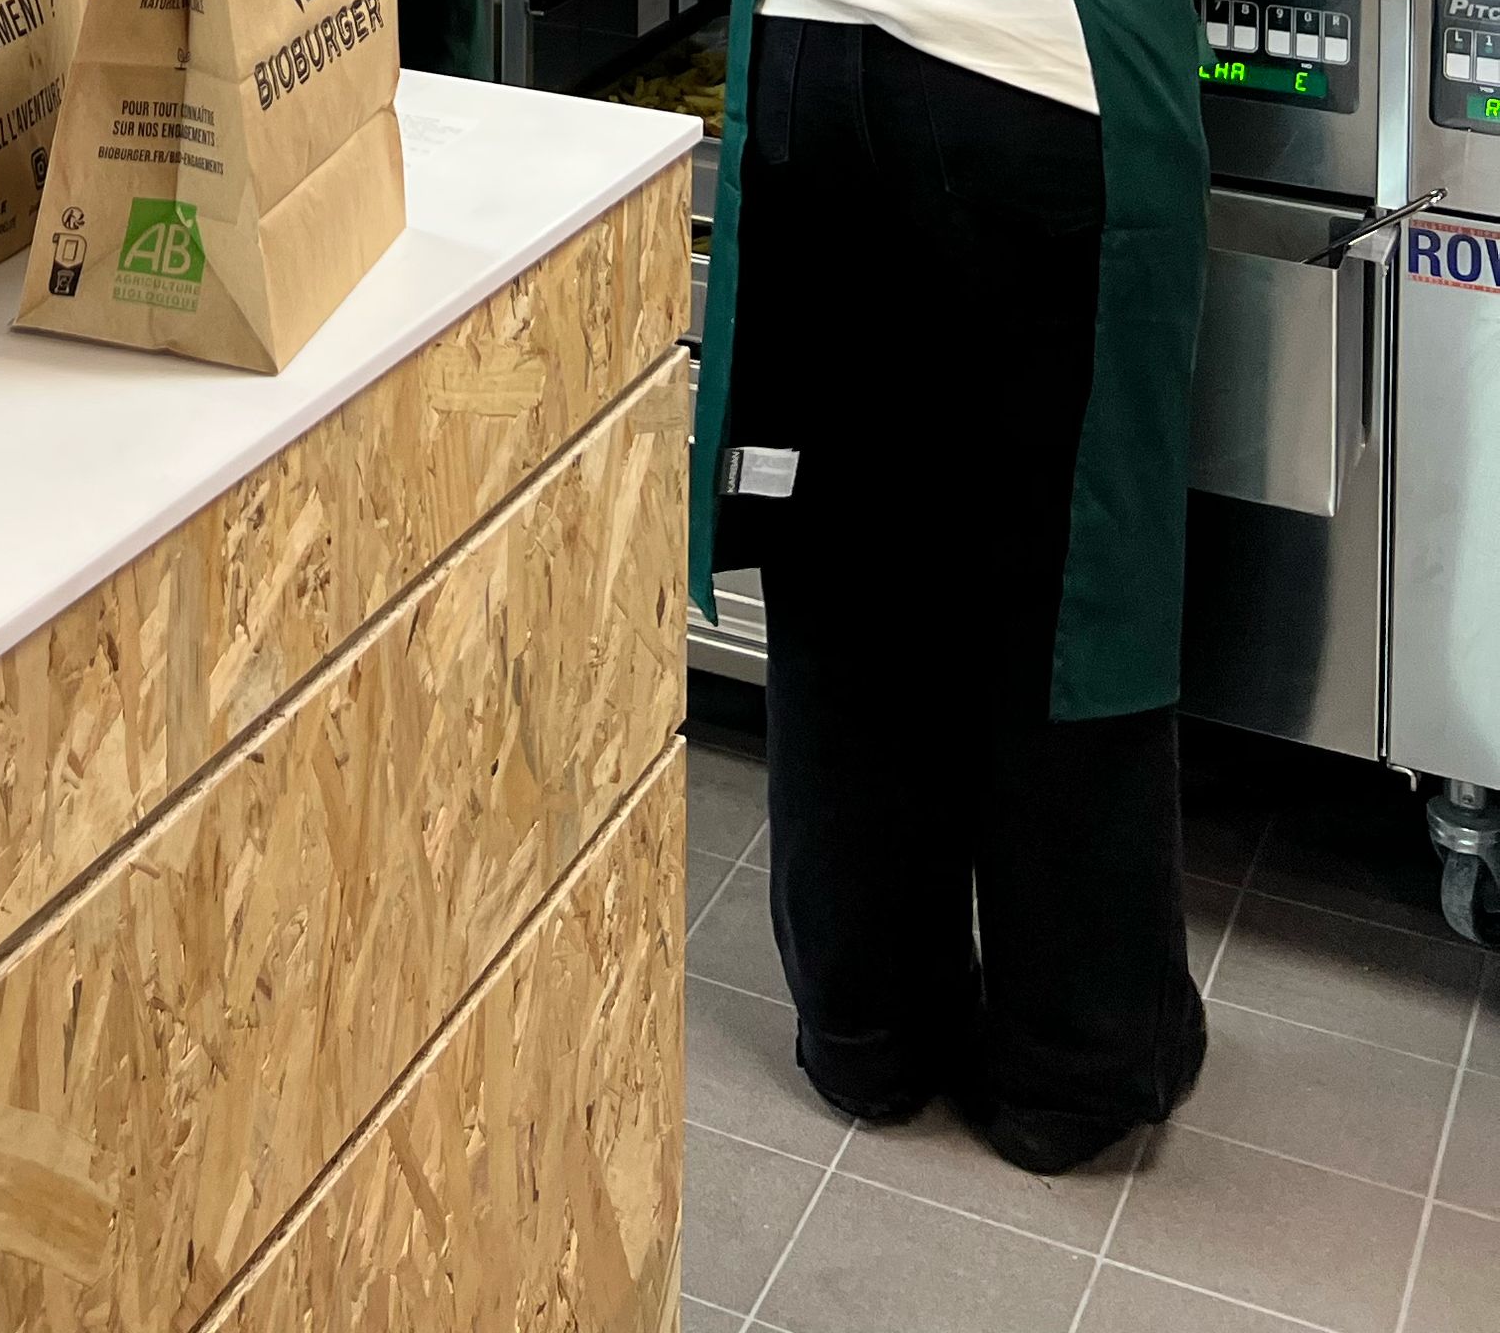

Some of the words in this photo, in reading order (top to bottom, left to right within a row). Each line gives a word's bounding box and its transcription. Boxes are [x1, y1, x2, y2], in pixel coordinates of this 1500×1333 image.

[1241, 3, 1250, 15] 8
[1276, 8, 1285, 19] 9
[1486, 35, 1493, 47] 1
[1295, 72, 1309, 92] E
[7, 77, 63, 141] L'AVENTURE
[121, 99, 150, 117] POUR
[152, 101, 179, 118] TOUT
[112, 120, 135, 136] SUR
[137, 121, 159, 138] NOS
[123, 222, 192, 275] AB
[115, 273, 201, 296] AGRICULTURE
